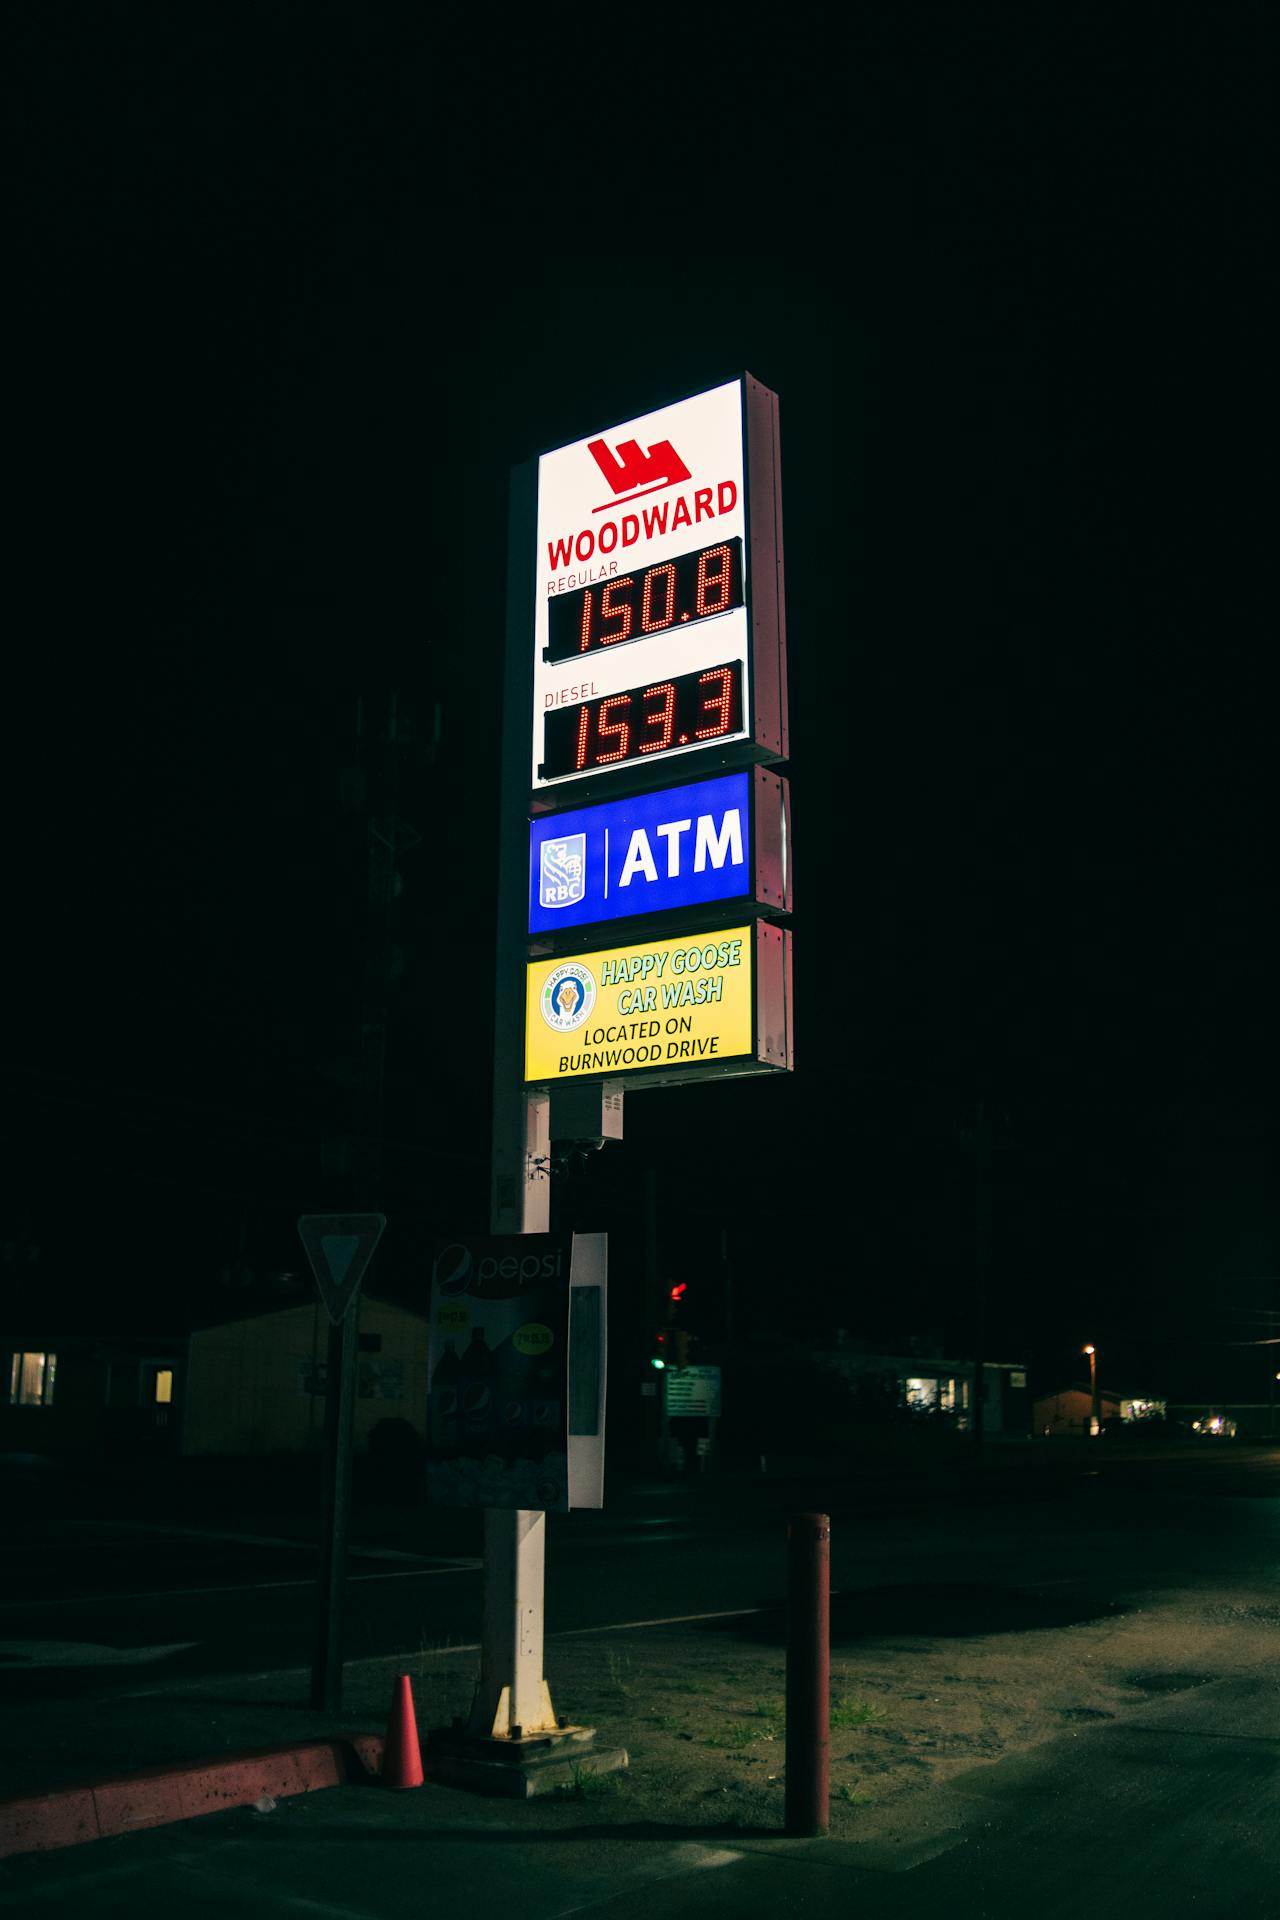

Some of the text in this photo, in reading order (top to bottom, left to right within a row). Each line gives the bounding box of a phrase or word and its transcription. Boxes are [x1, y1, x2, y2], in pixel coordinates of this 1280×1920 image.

[547, 479, 738, 572] WOODWARD
[547, 561, 619, 595] REGULAR
[579, 545, 732, 652] 150.8
[544, 681, 599, 709] DIESEL
[576, 667, 733, 770] 153.3
[618, 808, 745, 887] ATM
[545, 882, 581, 904] RBC
[548, 967, 569, 987] HAPPY
[600, 940, 743, 987] HAPPY GOOSE
[617, 976, 723, 1016] CAR WASH
[584, 1015, 692, 1047] LOCATED ON
[558, 1036, 720, 1073] BURNWOOD DRIVE
[477, 1248, 563, 1287] pepsi
